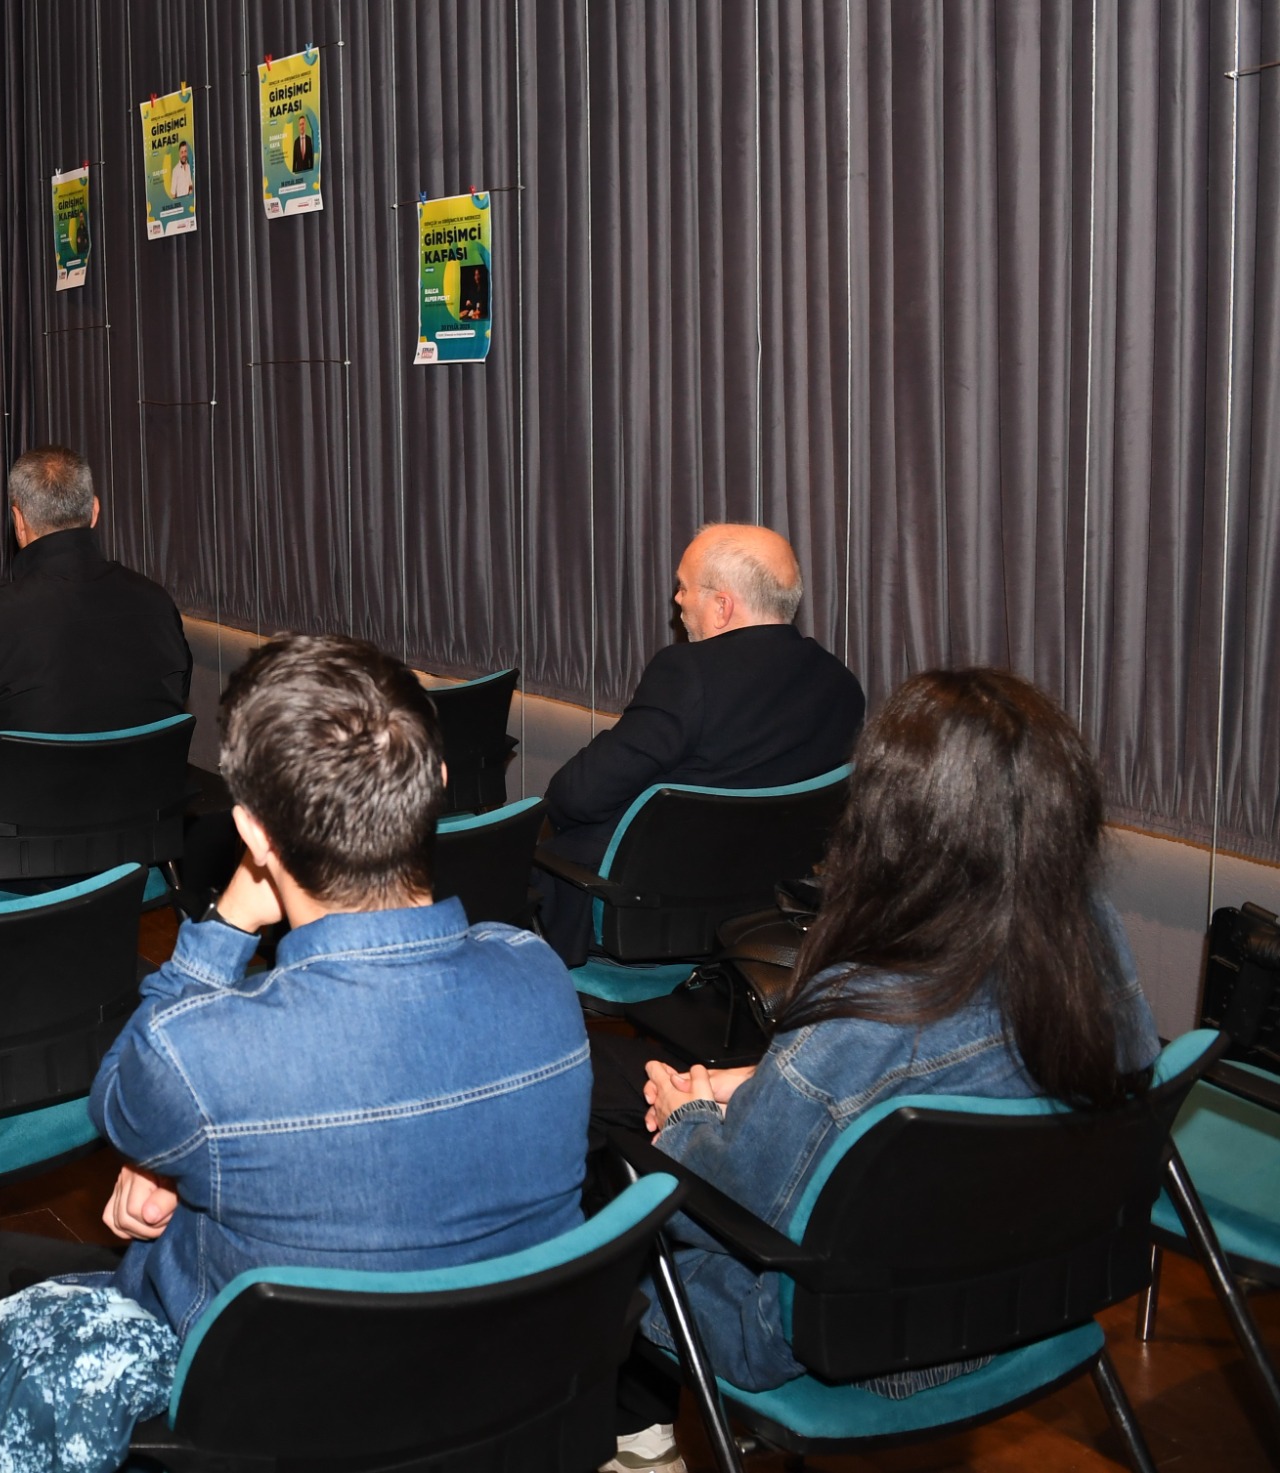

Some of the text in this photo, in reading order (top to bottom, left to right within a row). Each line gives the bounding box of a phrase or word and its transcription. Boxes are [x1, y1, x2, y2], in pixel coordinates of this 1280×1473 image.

[269, 78, 312, 103] GİRİŞİMCİ
[269, 99, 302, 118] KAFASI
[151, 113, 187, 136] GİRİŞİMCİ
[152, 133, 179, 150] KAFASI
[424, 223, 482, 246] GİRİŞİMCİ
[424, 247, 467, 264] KAFASI
